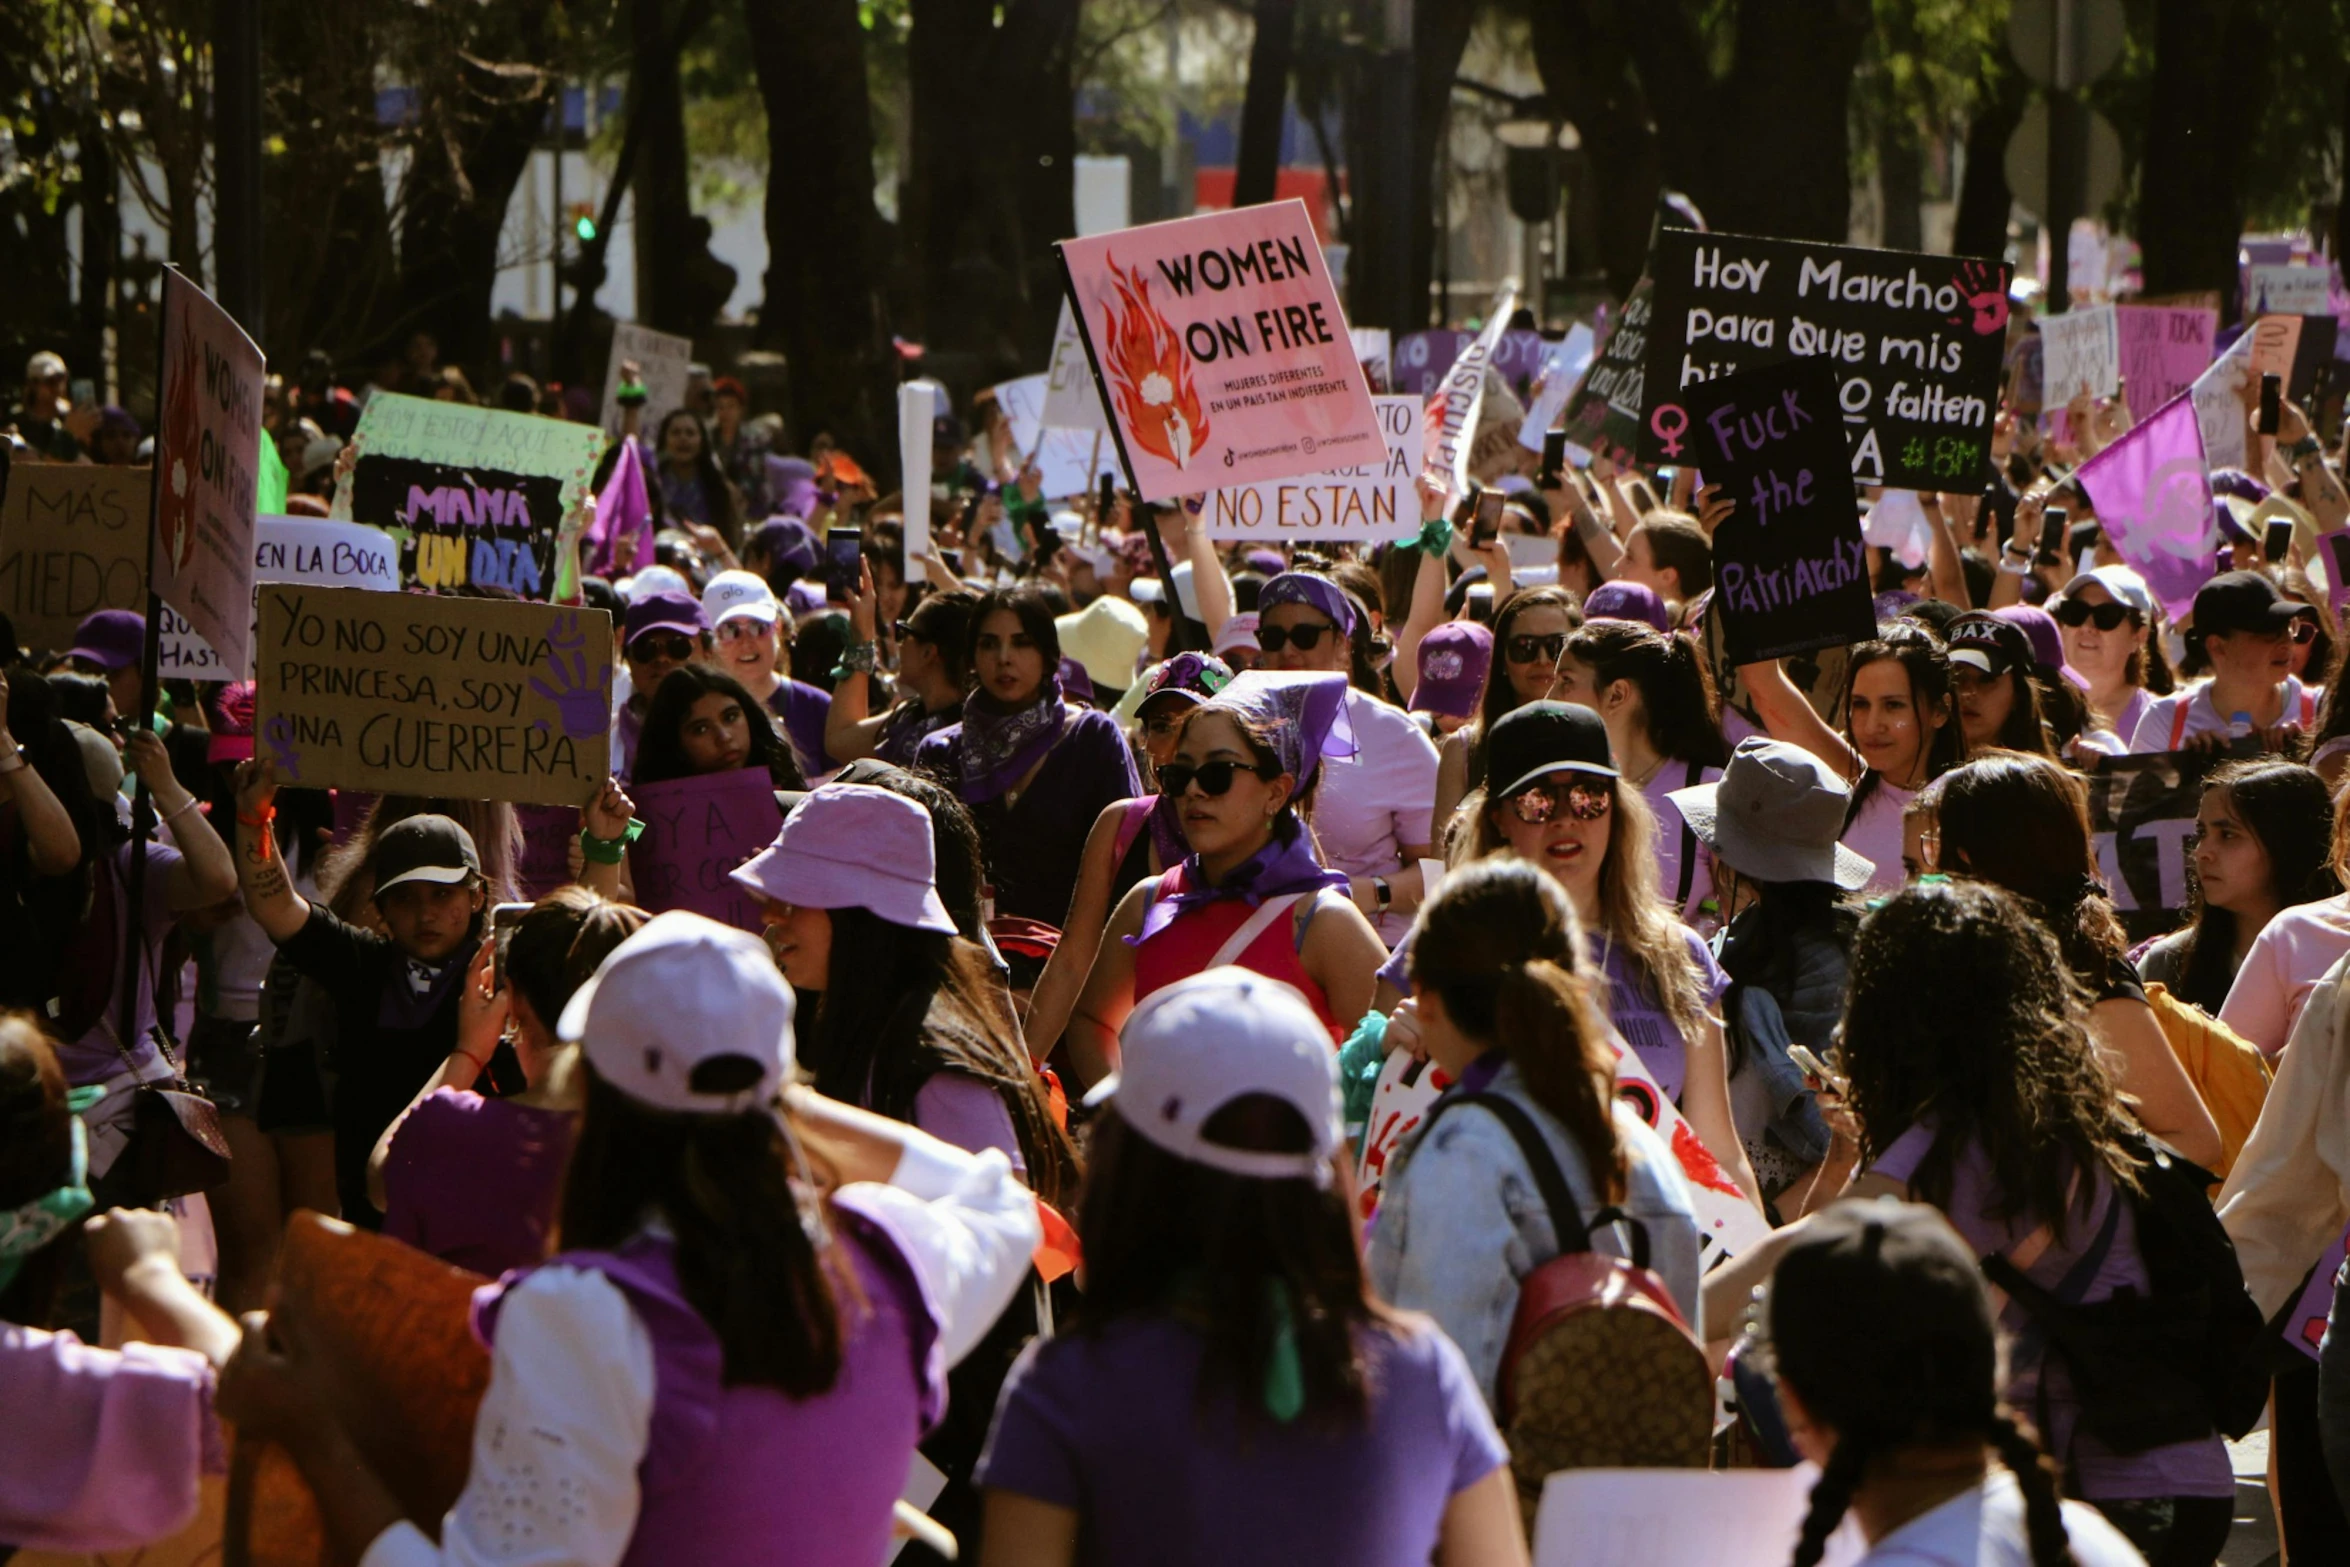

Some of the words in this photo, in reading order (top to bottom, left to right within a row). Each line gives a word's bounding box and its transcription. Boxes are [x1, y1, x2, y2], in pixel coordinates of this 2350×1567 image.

[1156, 235, 1311, 297] WOMEN
[1798, 256, 1959, 313] Marcho
[1186, 316, 1249, 363] ON
[1254, 302, 1334, 352] FIRE
[1686, 307, 1775, 348] para
[1879, 333, 1962, 373] mis
[1210, 402, 1224, 413] EN
[1226, 399, 1241, 410] UN
[1266, 390, 1286, 403] TAN
[1288, 379, 1349, 398] INDIFERENTE
[1224, 374, 1267, 392] MUJERES
[1268, 365, 1324, 385] DIFERENTES
[1885, 380, 1987, 428] falten
[26, 482, 128, 531] MÁS
[1216, 487, 1263, 527] NO
[1278, 485, 1396, 528] ESTAN
[1751, 468, 1817, 527] the
[256, 542, 286, 569] EN
[295, 545, 323, 574] LA
[333, 541, 392, 580] BOCA.
[276, 594, 325, 648] YO
[336, 618, 386, 653] NO
[403, 623, 467, 661] SOY
[477, 631, 552, 667] UNA
[1950, 623, 1999, 642] BAX
[279, 662, 447, 711] PRINCESA,
[453, 679, 522, 717] SOY
[276, 712, 343, 748] UNA
[358, 713, 593, 783] GUERRERA.
